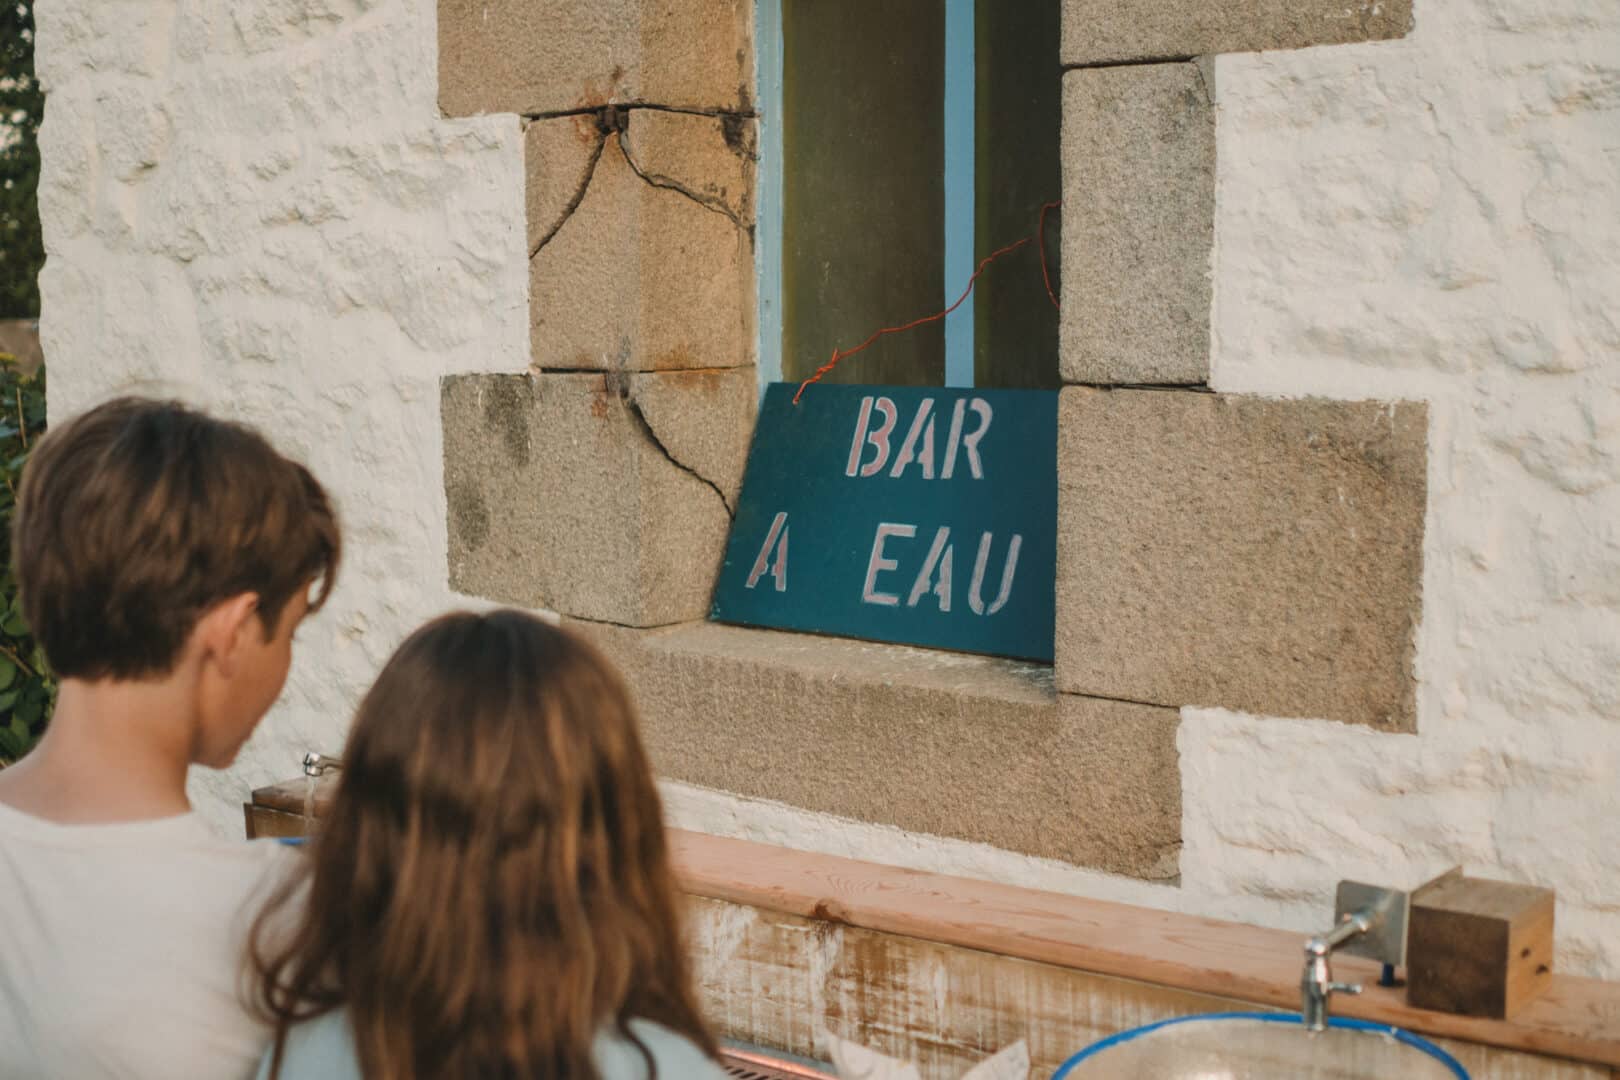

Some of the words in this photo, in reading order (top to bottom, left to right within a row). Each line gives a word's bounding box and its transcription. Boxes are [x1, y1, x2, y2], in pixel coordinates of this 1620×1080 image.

[845, 396, 993, 480] BAR
[745, 511, 788, 592] A
[861, 522, 1022, 616] EAU
